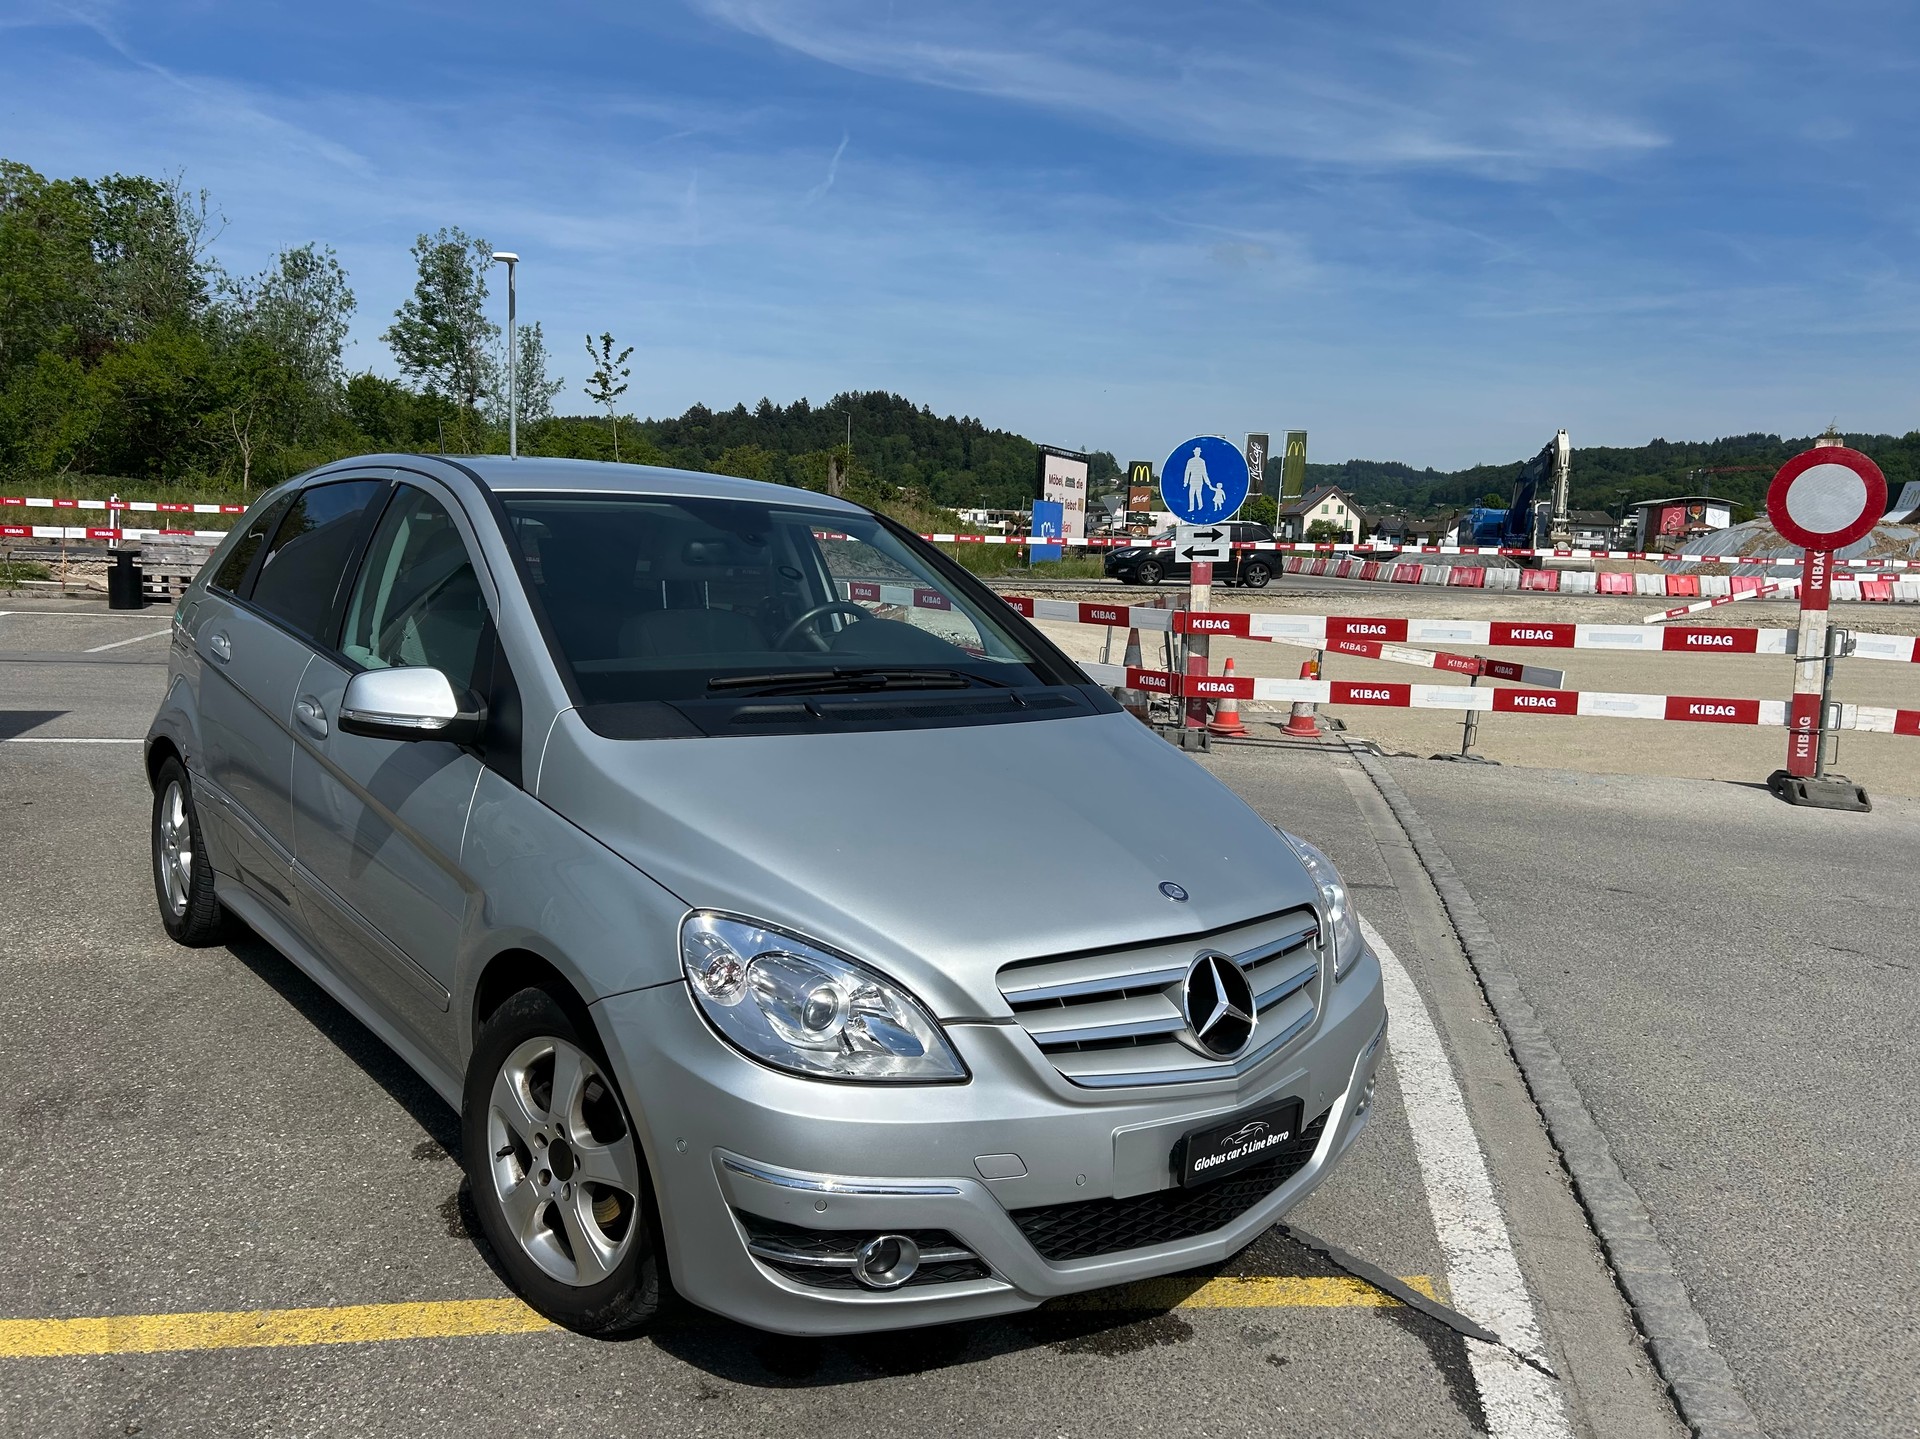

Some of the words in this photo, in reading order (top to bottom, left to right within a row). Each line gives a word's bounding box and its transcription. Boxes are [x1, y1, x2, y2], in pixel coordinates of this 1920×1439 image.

[855, 588, 872, 597] KIBAG
[922, 595, 941, 605] KIBAG
[1091, 610, 1116, 620] KIBAG
[1192, 619, 1230, 629] KIBAG
[1346, 624, 1386, 635] KIBAG
[1511, 629, 1554, 640] KIBAG
[1687, 634, 1733, 646] KIBAG
[1339, 641, 1367, 652] KIBAG
[1494, 665, 1514, 675] KIBAG
[1139, 675, 1166, 687] KIBAG
[1197, 682, 1235, 693] KIBAG
[1350, 689, 1390, 700] KIBAG
[1514, 696, 1557, 707] KIBAG
[1689, 704, 1736, 716] KIBAG
[1796, 716, 1811, 758] KIBAG
[1194, 1153, 1226, 1171] Globus
[1227, 1148, 1241, 1160] car
[1241, 1144, 1248, 1156] S
[1248, 1140, 1265, 1154] Line
[1267, 1131, 1289, 1146] Berro
